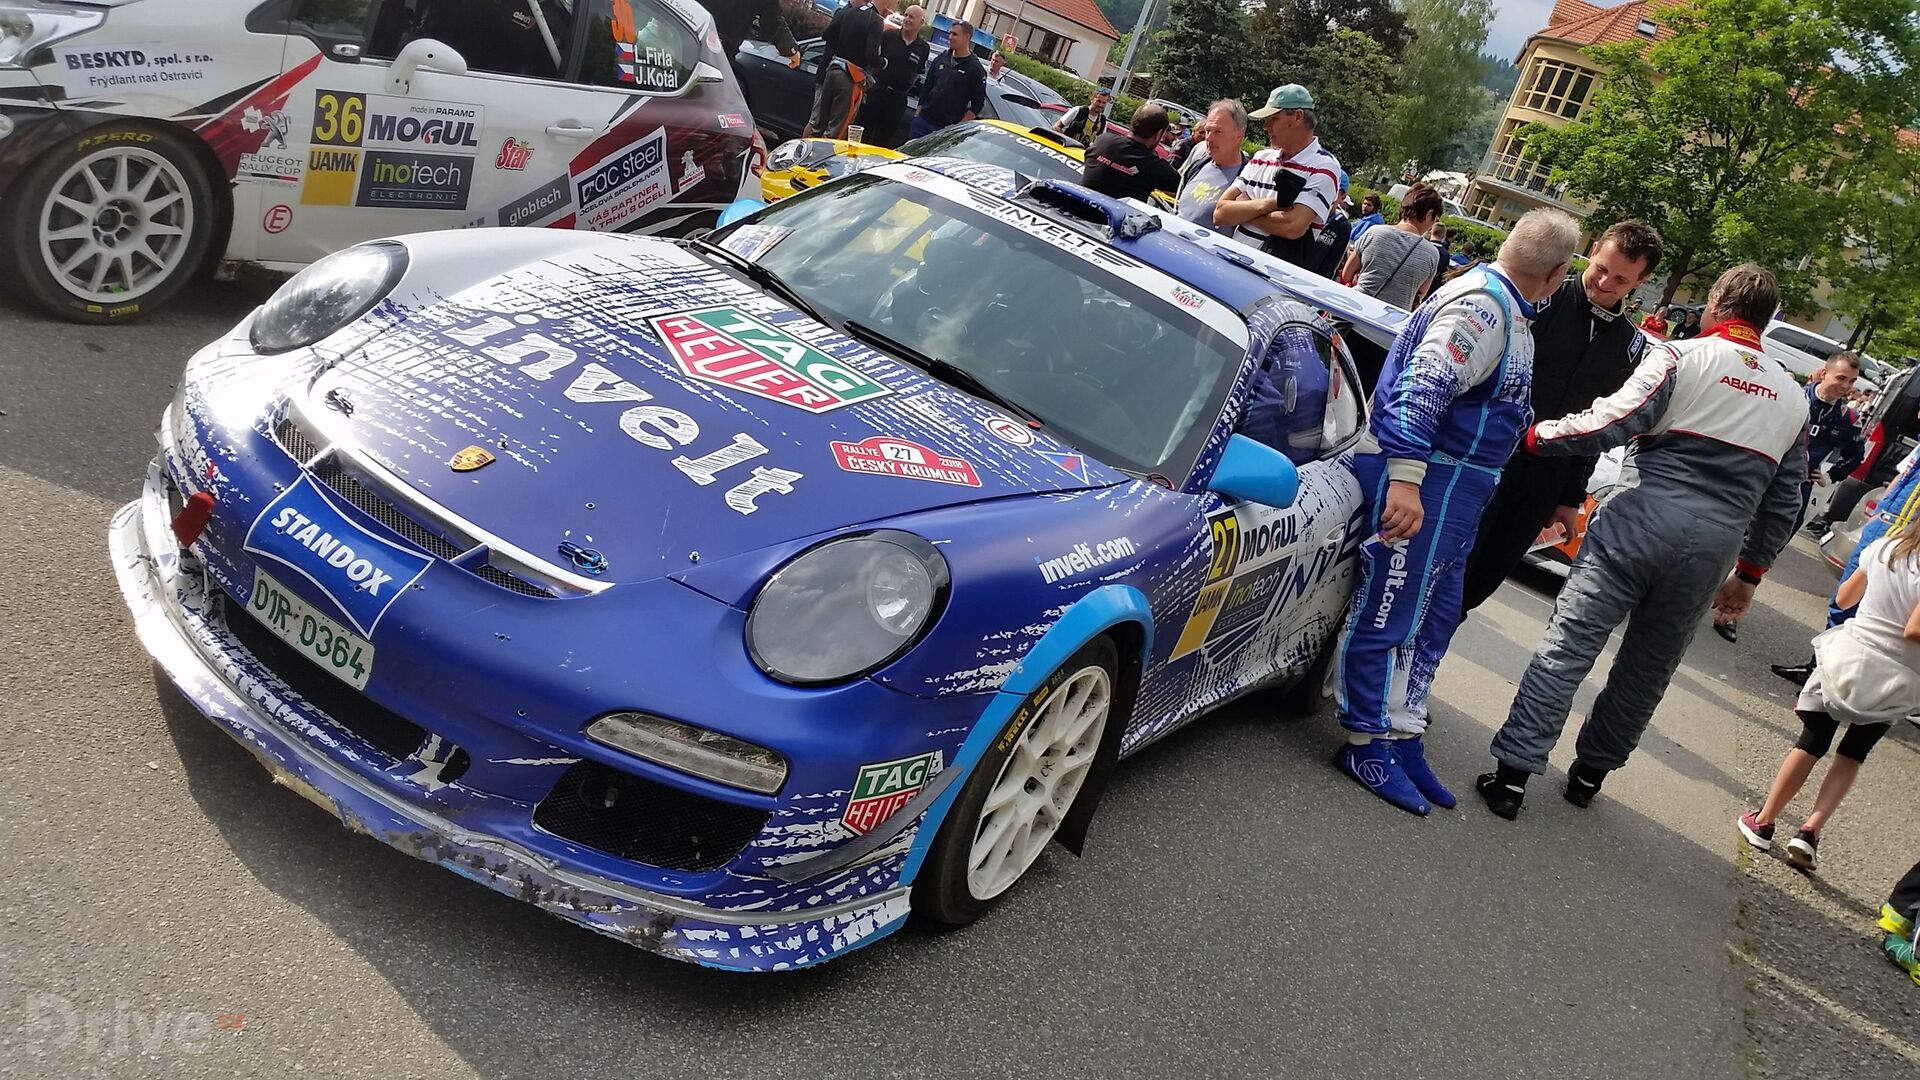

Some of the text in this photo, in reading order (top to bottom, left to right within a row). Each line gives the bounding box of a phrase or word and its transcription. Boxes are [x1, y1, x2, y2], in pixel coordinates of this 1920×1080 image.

[65, 50, 213, 70] BESKYD, spol. s r.o.
[634, 44, 673, 67] L.Firla
[89, 74, 136, 88] Frýdlant
[139, 73, 157, 83] nad
[635, 66, 678, 88] J.Kotál
[315, 94, 363, 143] 36
[410, 105, 475, 118] made in PARAMO
[368, 114, 478, 147] MOGUL
[974, 124, 1008, 138] MP
[240, 162, 301, 176] RALLY CUP
[241, 153, 303, 167] PEUGEOT
[373, 158, 462, 186] inotech
[495, 137, 534, 171] Star
[622, 138, 661, 180] steel
[370, 190, 457, 201] ELECTRONIC
[509, 188, 562, 226] globtech
[588, 182, 659, 225] VÁŠ PARTNER
[599, 209, 628, 229] TRHU
[638, 184, 667, 209] OCELÍ
[269, 207, 288, 229] E
[976, 204, 1028, 229] RALLIED
[1047, 236, 1103, 264] RACED
[1000, 205, 1096, 249] INVELT
[1460, 299, 1498, 329] invelt
[1467, 315, 1485, 334] Castrol
[665, 318, 831, 406] HEUER
[719, 313, 867, 392] TAG
[1719, 375, 1778, 401] ABARTH
[441, 314, 805, 516] invelt
[842, 443, 963, 469] RALLYE 27 2018
[846, 454, 970, 484] ČESKÝ KRUMLOV
[270, 507, 392, 597] STANDOX
[1208, 516, 1238, 581] 27
[1239, 513, 1298, 565] MOGUL
[1034, 536, 1136, 584] invelt.com
[1264, 502, 1363, 626] INVE
[1225, 566, 1281, 611] inotech
[1373, 538, 1410, 629] velt.com
[299, 614, 366, 680] 0364
[865, 760, 926, 796] TAG
